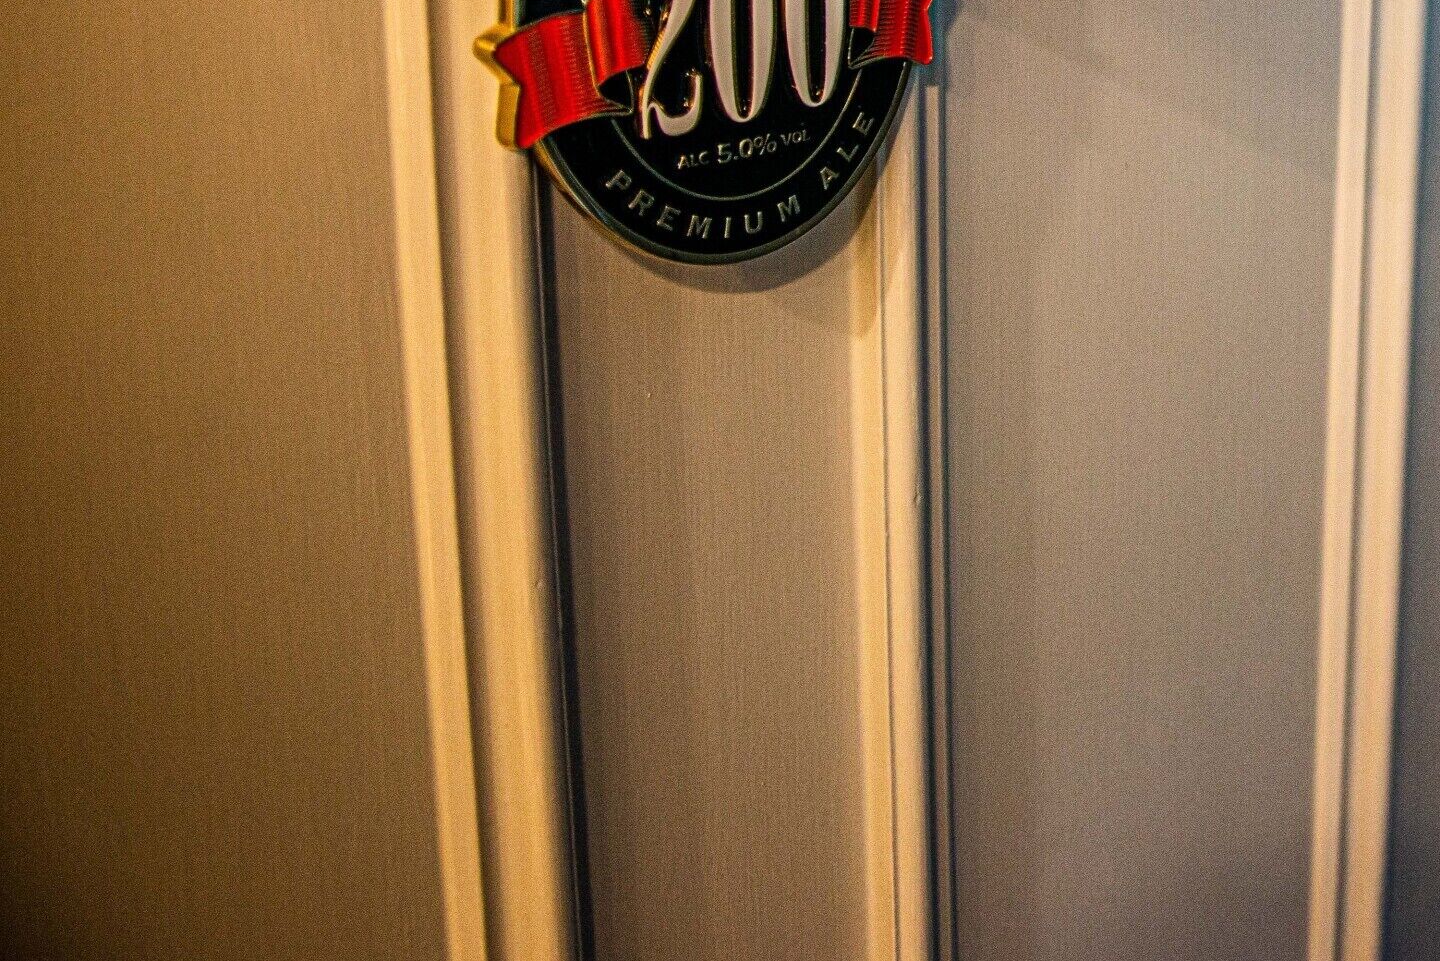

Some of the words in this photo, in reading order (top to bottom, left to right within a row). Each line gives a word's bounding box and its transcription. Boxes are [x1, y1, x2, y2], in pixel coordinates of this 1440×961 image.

[605, 169, 801, 239] PREMIUM
[819, 111, 876, 190] ALE
[677, 151, 710, 170] ALC
[717, 133, 778, 164] 5.0%
[780, 128, 811, 147] VOL
